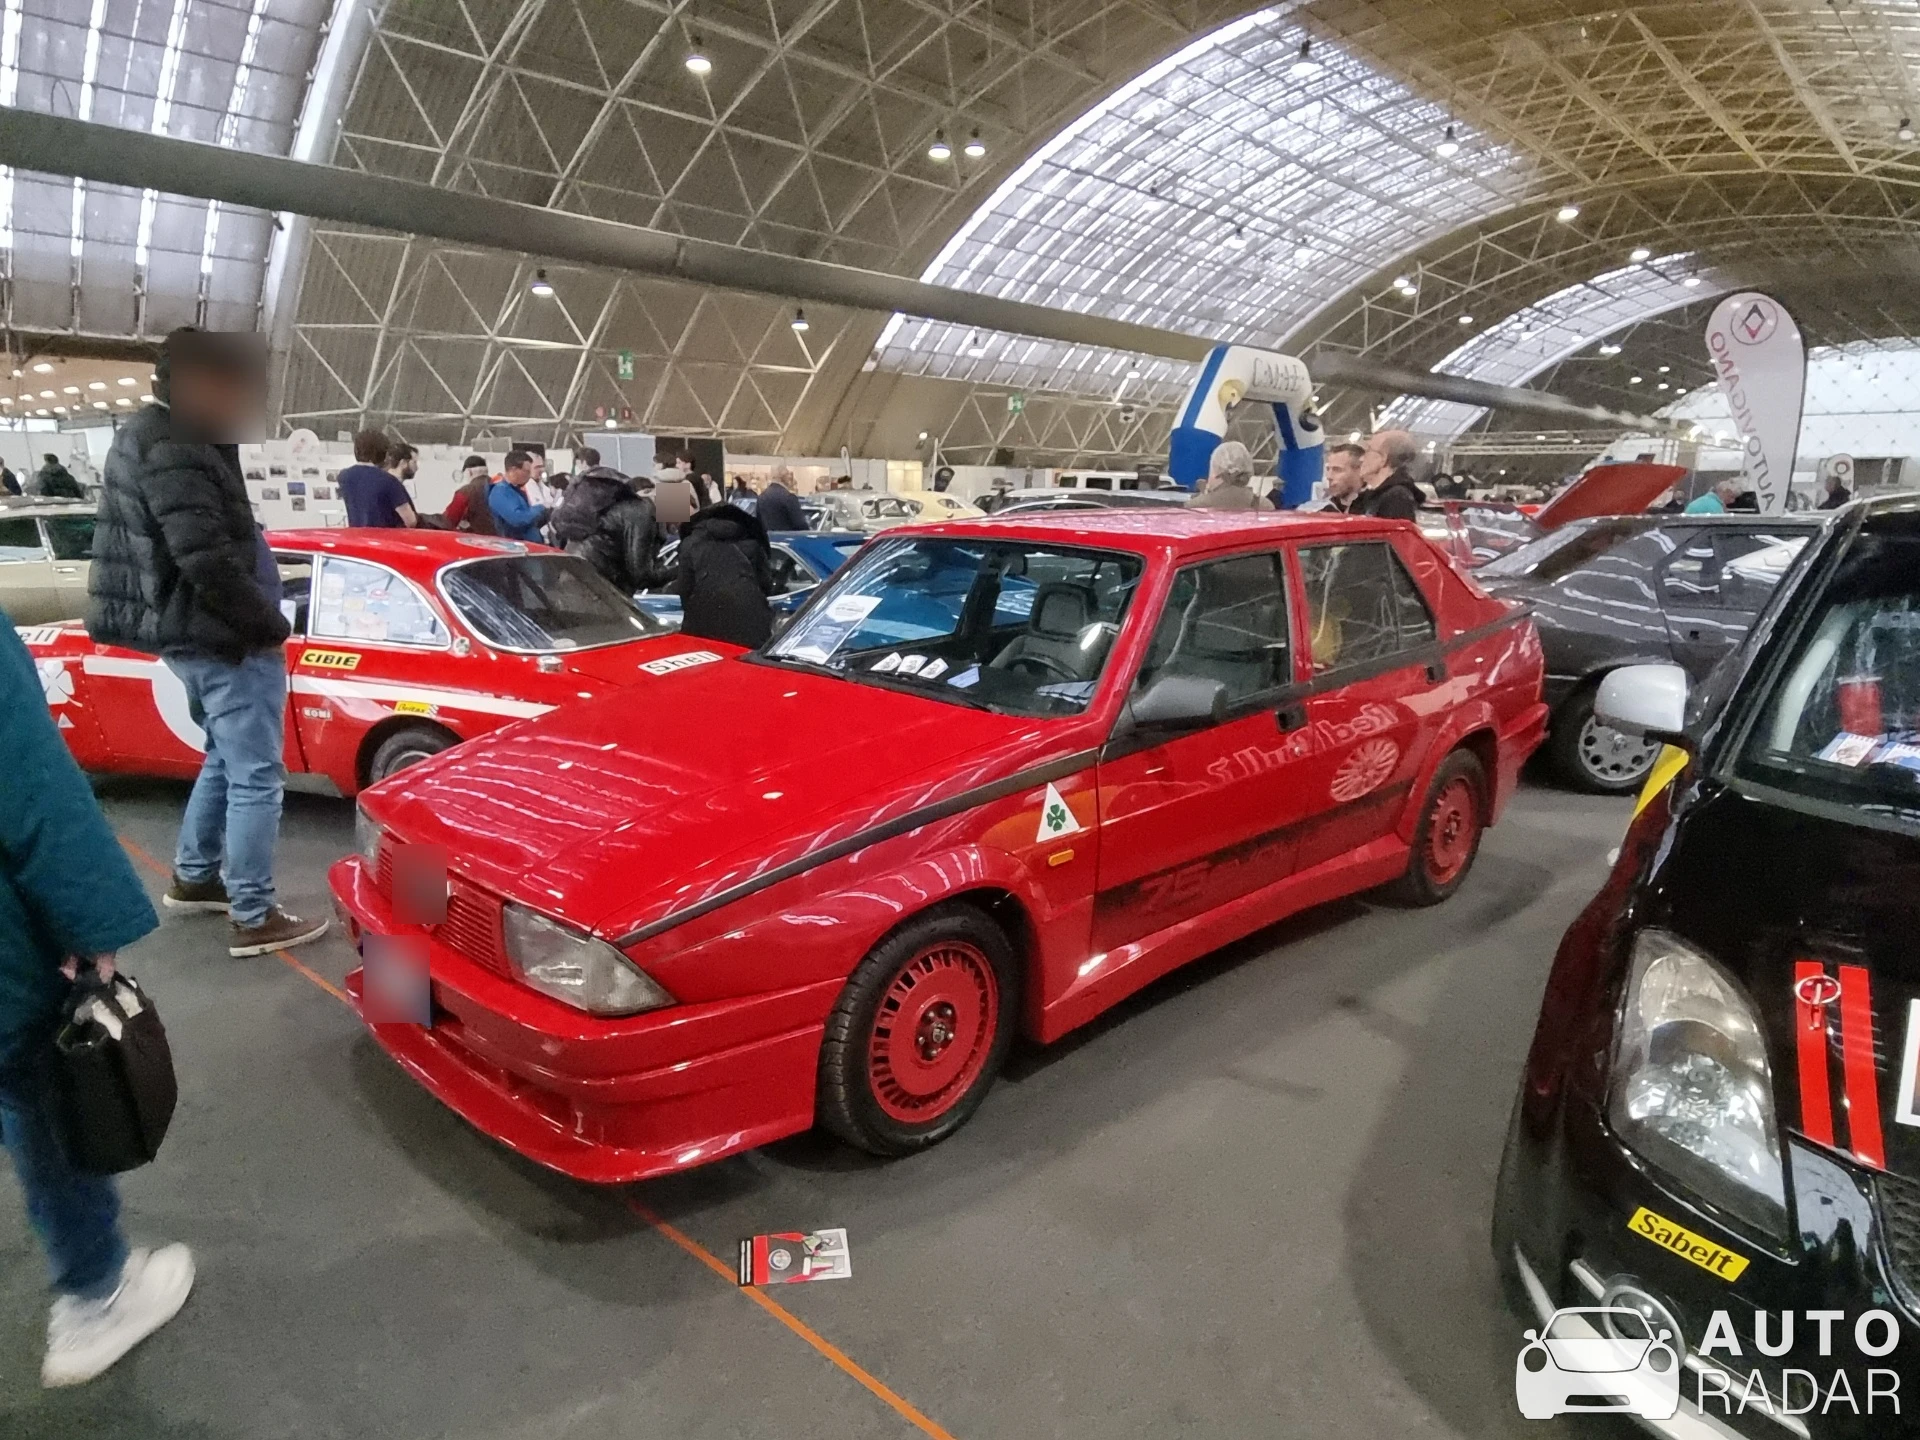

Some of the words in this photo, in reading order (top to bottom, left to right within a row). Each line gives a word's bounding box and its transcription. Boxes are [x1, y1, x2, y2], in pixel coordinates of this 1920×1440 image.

[20, 630, 56, 642] ell
[304, 653, 359, 667] CIBIE
[645, 652, 719, 673] Shell
[1637, 1213, 1737, 1277] Sabelt
